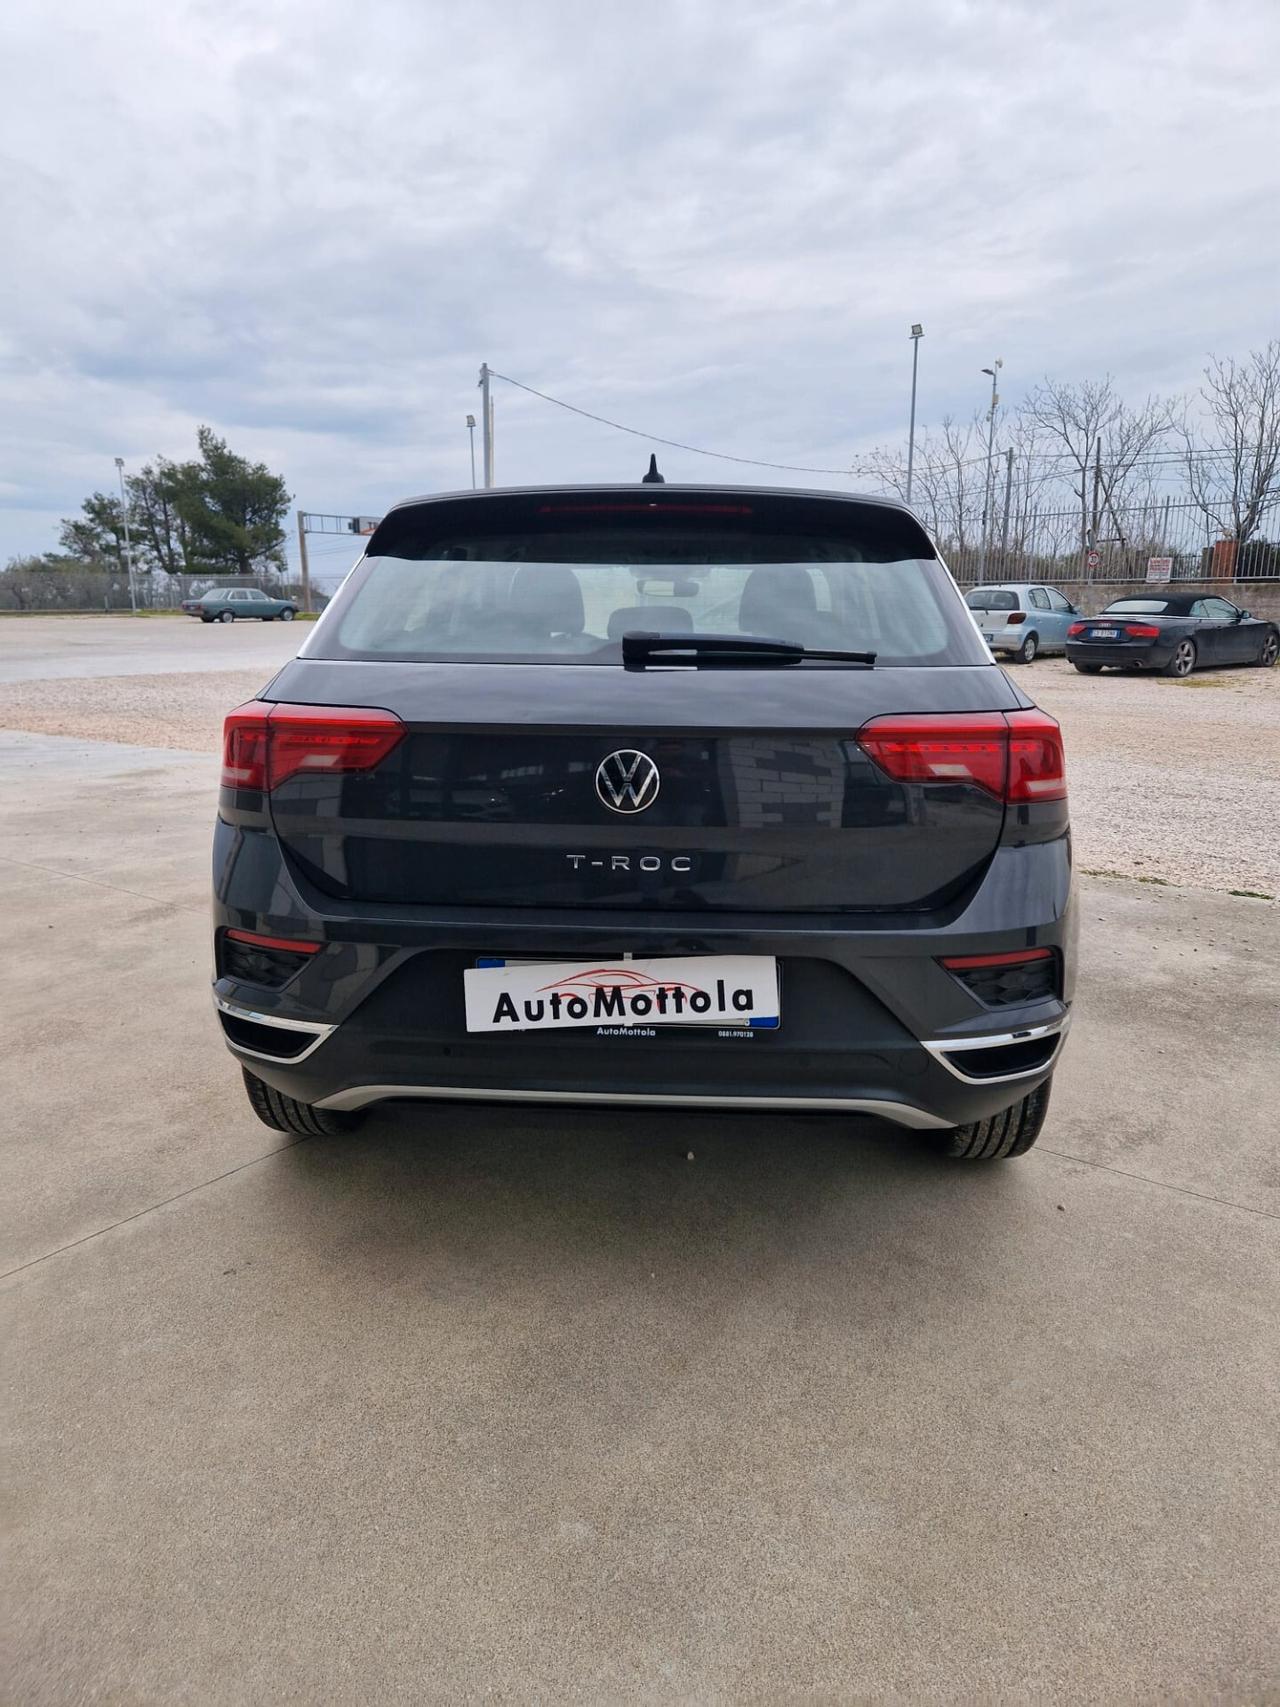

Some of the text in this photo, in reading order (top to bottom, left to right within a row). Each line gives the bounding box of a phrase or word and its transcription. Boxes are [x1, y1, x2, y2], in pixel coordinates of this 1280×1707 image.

[565, 854, 691, 872] T-ROC
[492, 979, 755, 1023] AutoMottola
[597, 1027, 656, 1037] AutoMottola
